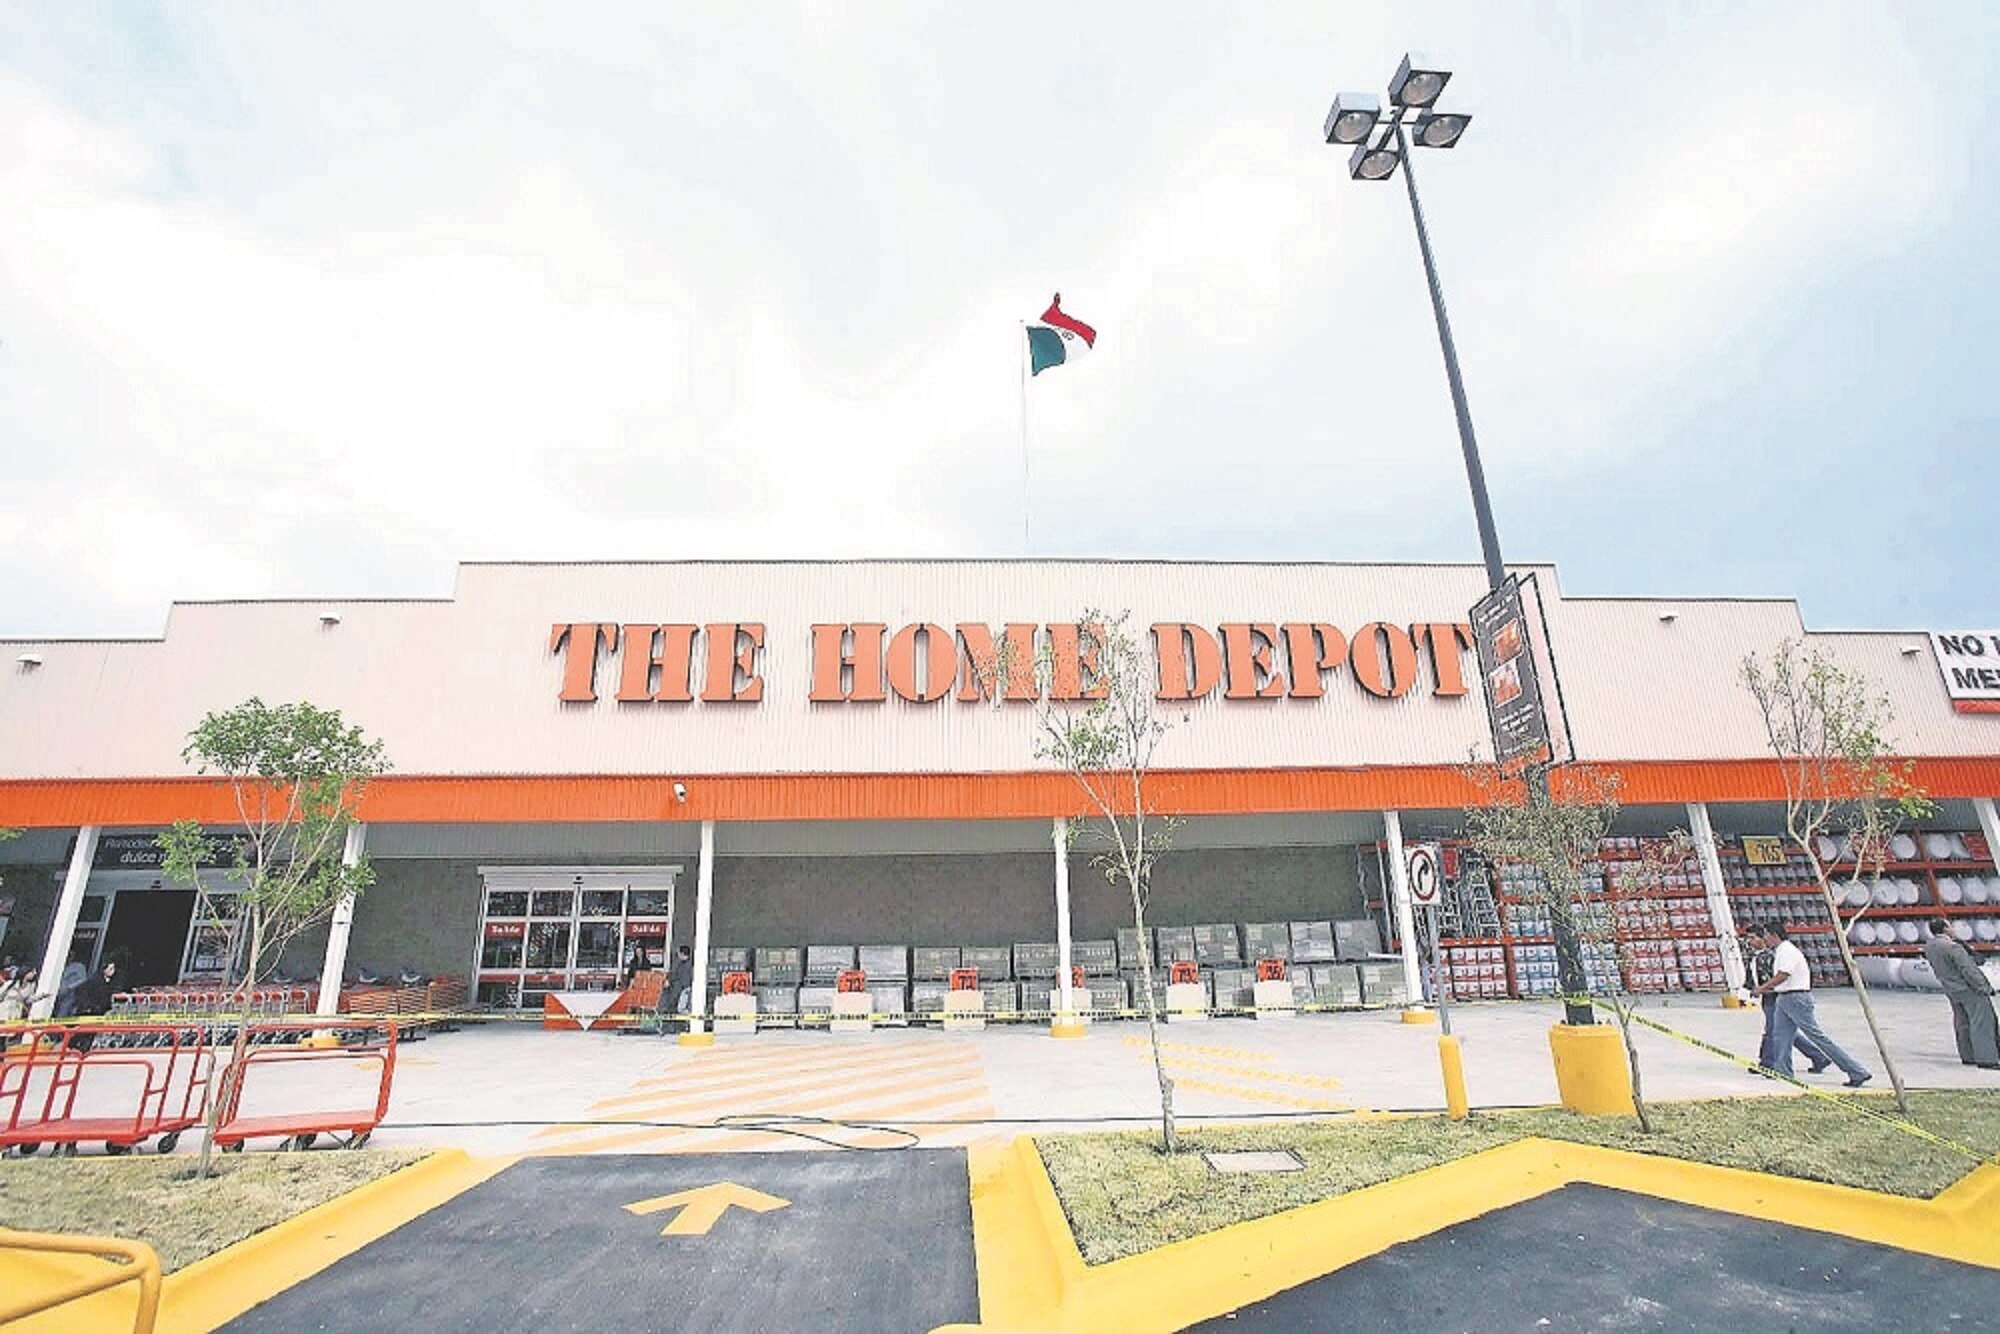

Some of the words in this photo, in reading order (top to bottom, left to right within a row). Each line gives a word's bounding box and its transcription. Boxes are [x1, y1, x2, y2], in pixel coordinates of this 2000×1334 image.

[1937, 634, 1985, 656] NO
[549, 623, 765, 703] THE
[808, 622, 1111, 703] HOME
[1149, 621, 1474, 699] DEPOT
[1951, 667, 2000, 689] ME
